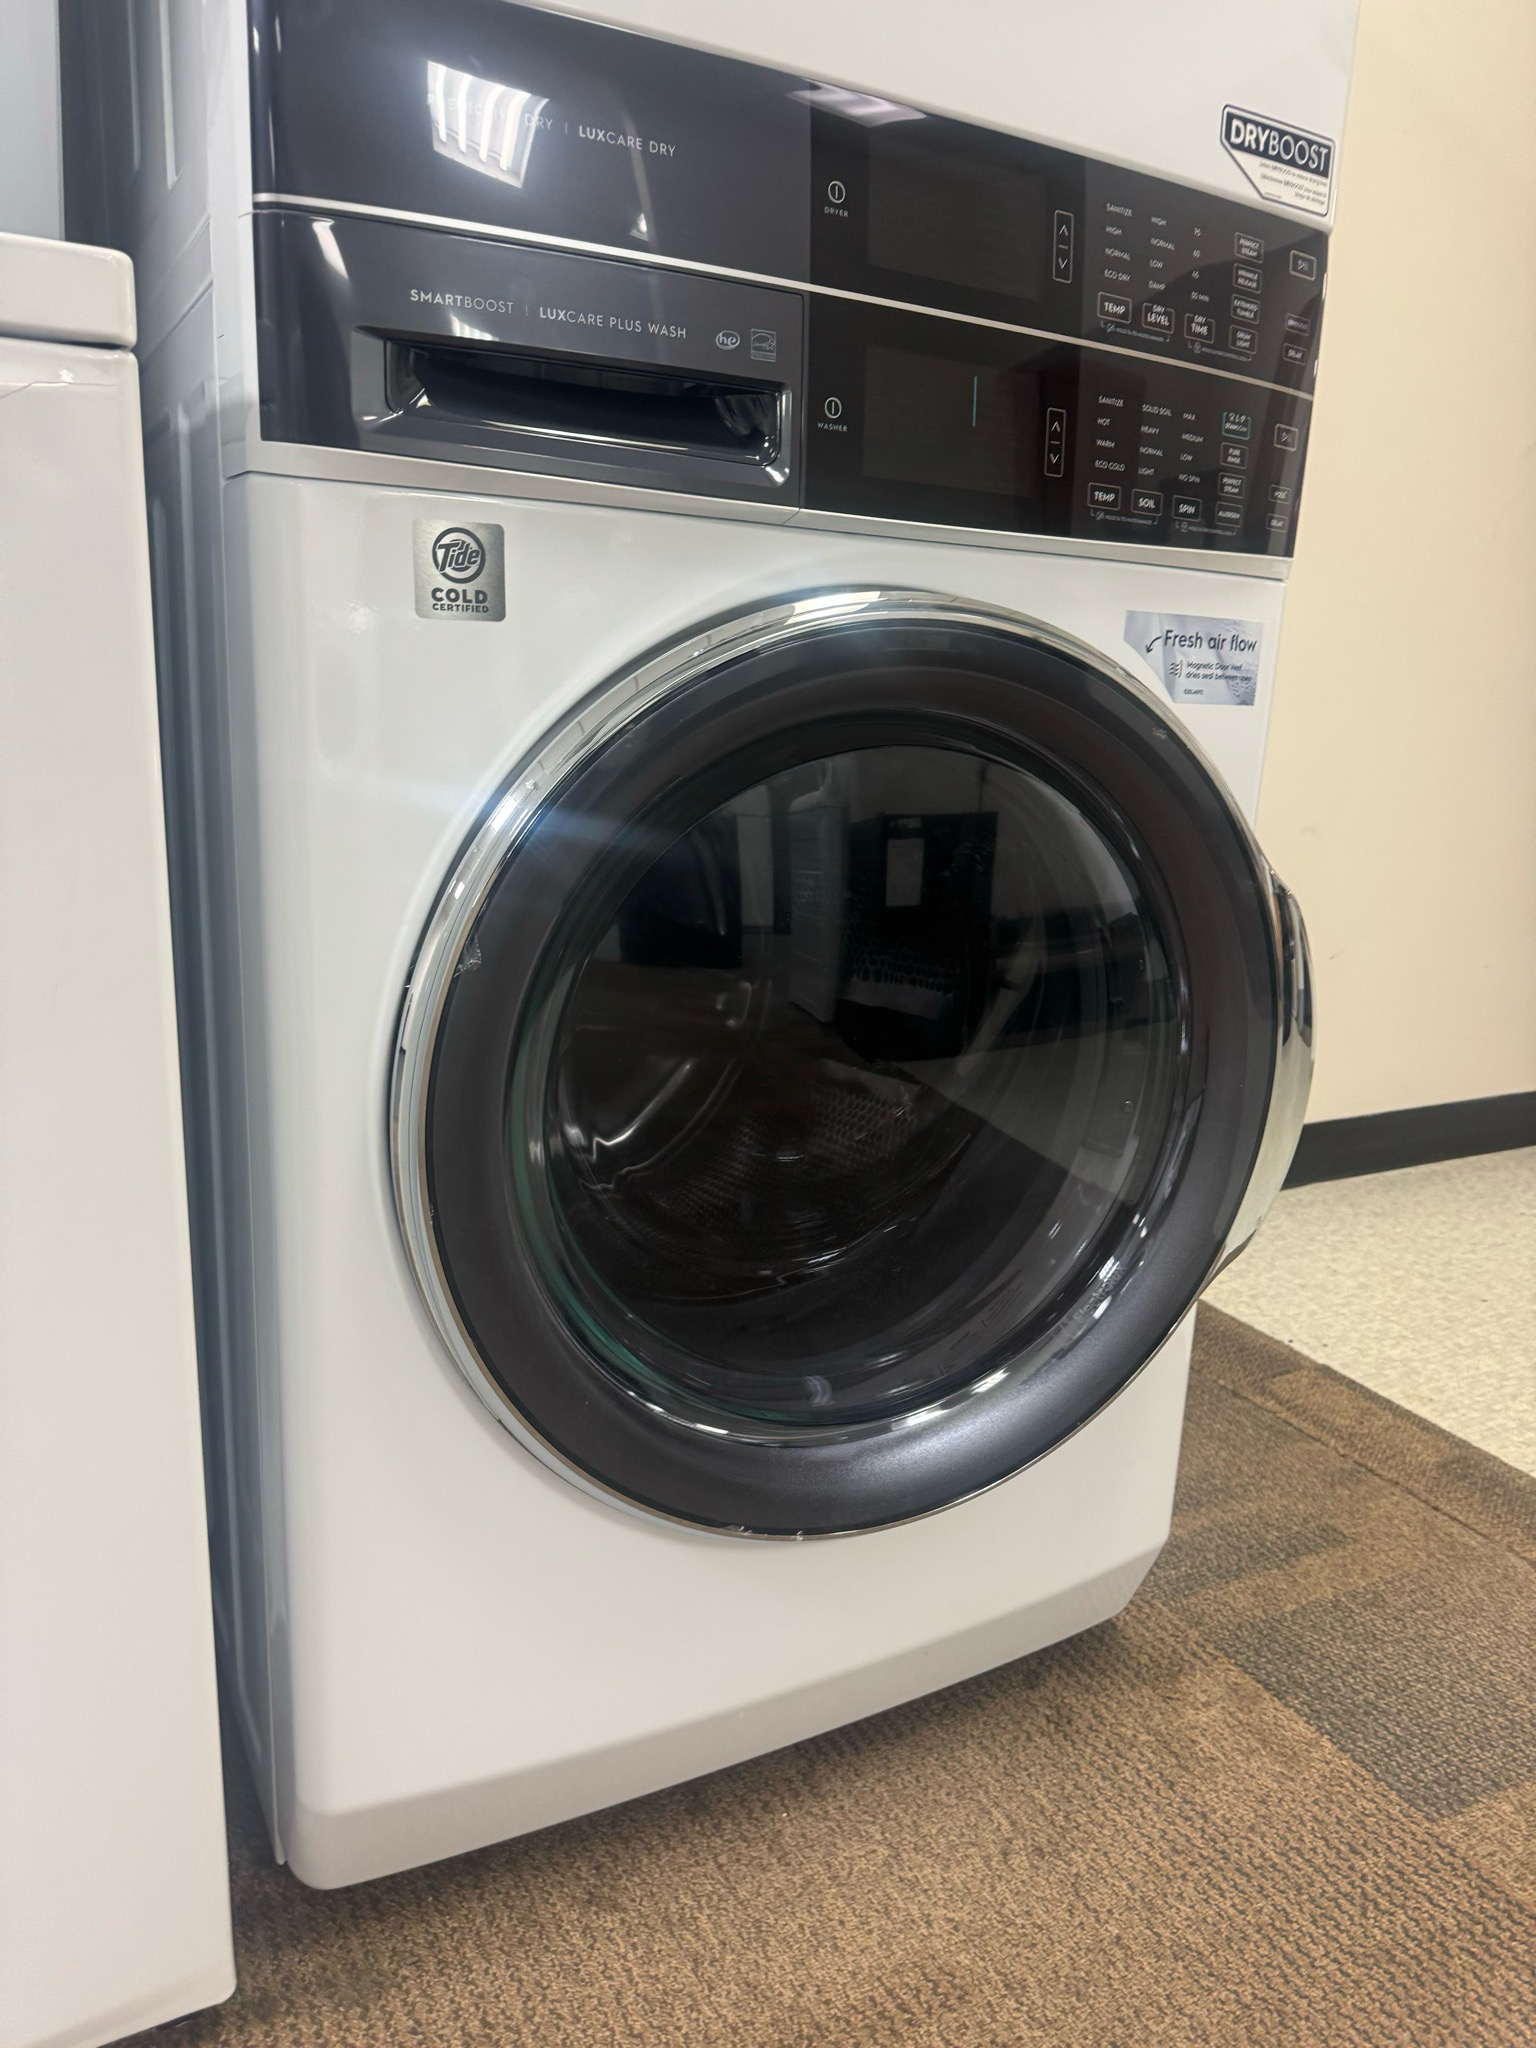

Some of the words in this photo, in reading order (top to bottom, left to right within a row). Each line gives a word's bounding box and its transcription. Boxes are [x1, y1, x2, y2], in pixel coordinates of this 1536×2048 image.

[524, 113, 553, 130] DRY
[578, 125, 643, 150] LUXCARE
[649, 141, 676, 157] DRY
[1230, 118, 1329, 171] DRYBOOST
[824, 206, 849, 218] DRYER
[1150, 237, 1175, 251] NORMAL
[1105, 247, 1131, 261] NORMAL
[1149, 259, 1163, 269] LOW
[1104, 269, 1118, 280] ECO
[1118, 272, 1131, 282] DRY
[410, 289, 514, 314] SMARTBOOST
[539, 306, 604, 327] LUXCARE
[609, 316, 642, 333] PLUS
[648, 322, 686, 339] WASH
[1104, 301, 1126, 315] TEMP
[1152, 304, 1166, 314] DRY
[1147, 312, 1170, 327] LEVEL
[1194, 315, 1207, 324] DRY
[1191, 323, 1209, 336] TIME
[1098, 395, 1125, 408] SANITIZE
[1097, 417, 1111, 427] HOT
[1183, 412, 1196, 421] MAX
[816, 421, 848, 433] WASHER
[1141, 425, 1160, 435] HEAVY
[1096, 438, 1116, 449] WARM
[1181, 433, 1204, 444] MEDIUM
[1140, 446, 1163, 457] NORMAL
[1180, 453, 1193, 462] LOW
[1094, 459, 1108, 470] ECO
[1108, 461, 1126, 472] COLD
[1179, 473, 1188, 483] NO
[1188, 474, 1201, 484] SPIN
[1093, 491, 1116, 503] TEMP
[1138, 497, 1156, 510] SOIL
[1178, 503, 1196, 515] SPIN
[437, 541, 481, 573] Tide
[431, 587, 488, 604] COLD
[432, 603, 489, 613] CERTIFIED
[1164, 629, 1202, 649] Fresh
[1208, 633, 1227, 651] air
[1230, 633, 1258, 653] flow
